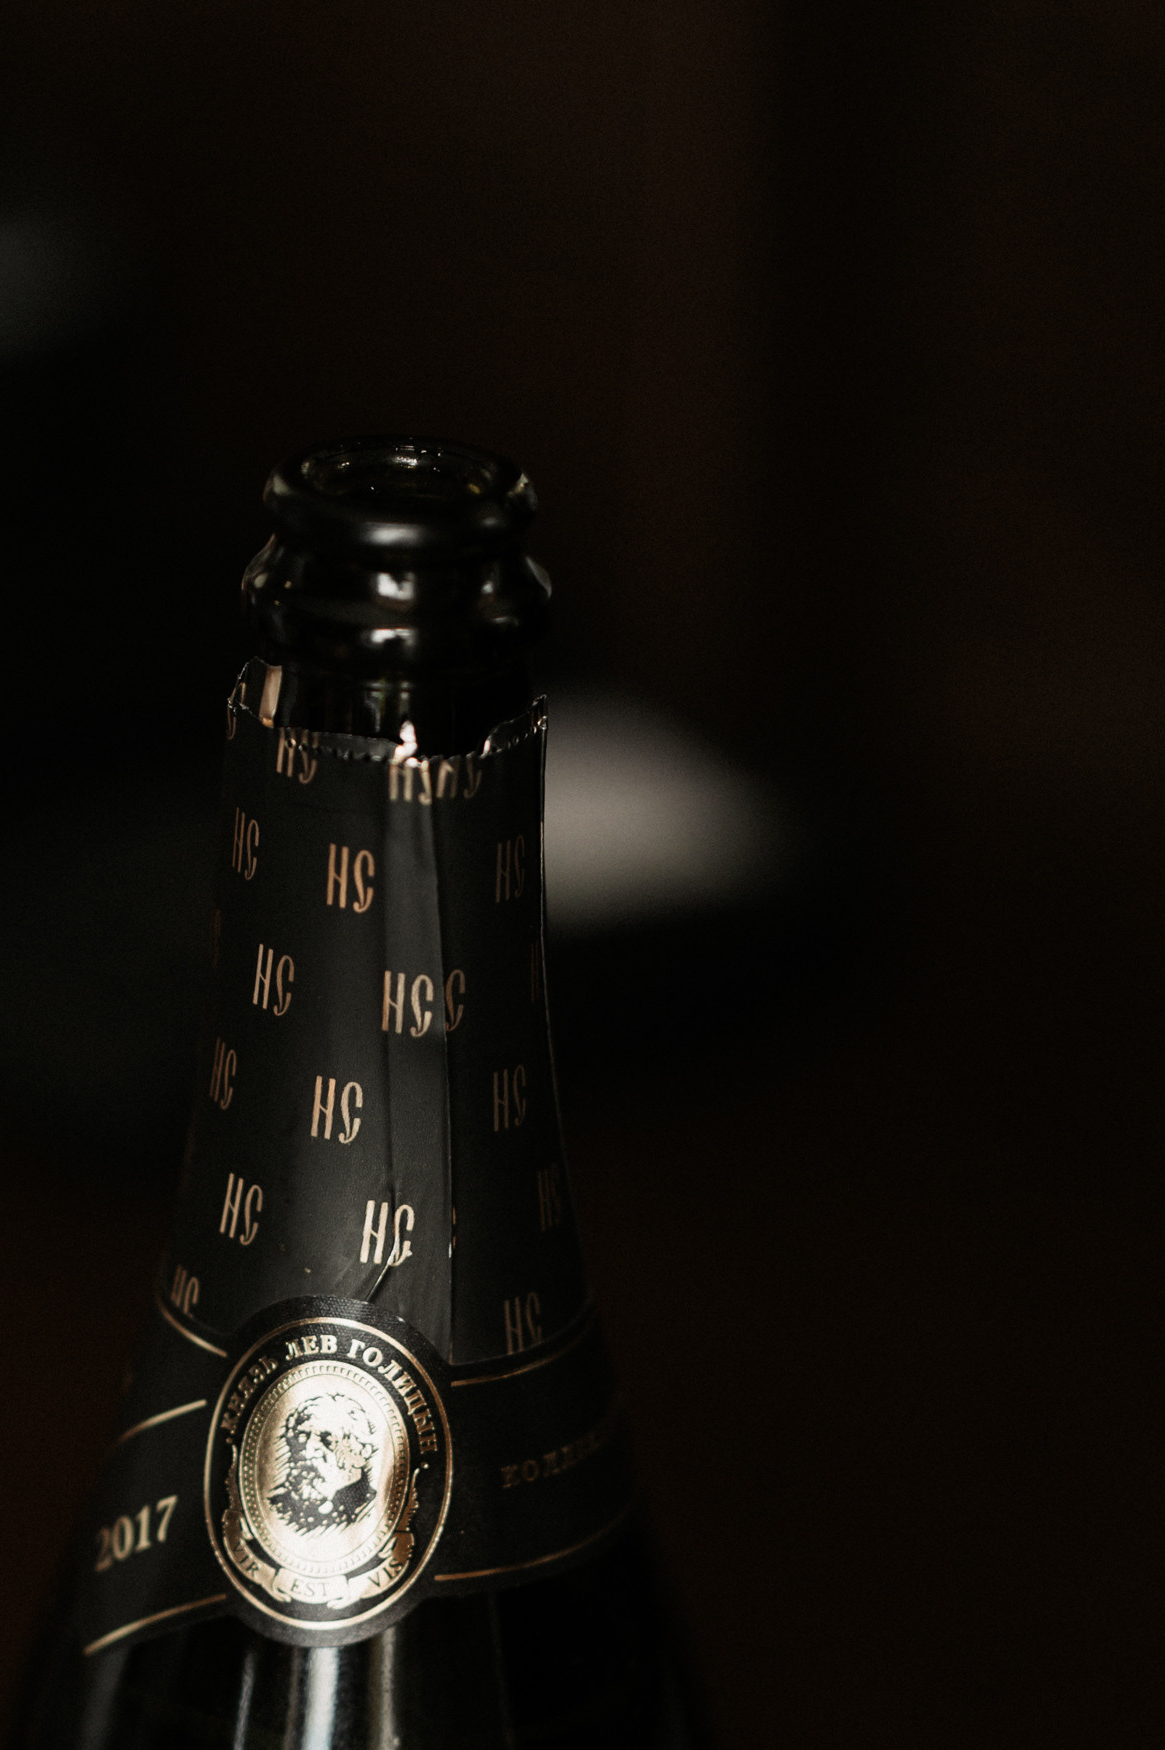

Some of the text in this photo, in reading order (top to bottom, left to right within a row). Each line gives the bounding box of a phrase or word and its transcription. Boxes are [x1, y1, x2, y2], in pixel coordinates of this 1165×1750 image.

[286, 1334, 337, 1360] ЛЕВ
[347, 1339, 437, 1453] ГОЛИЦЫН
[94, 1494, 178, 1572] 2017
[290, 1577, 330, 1598] EST
[368, 1557, 403, 1588] VIS
